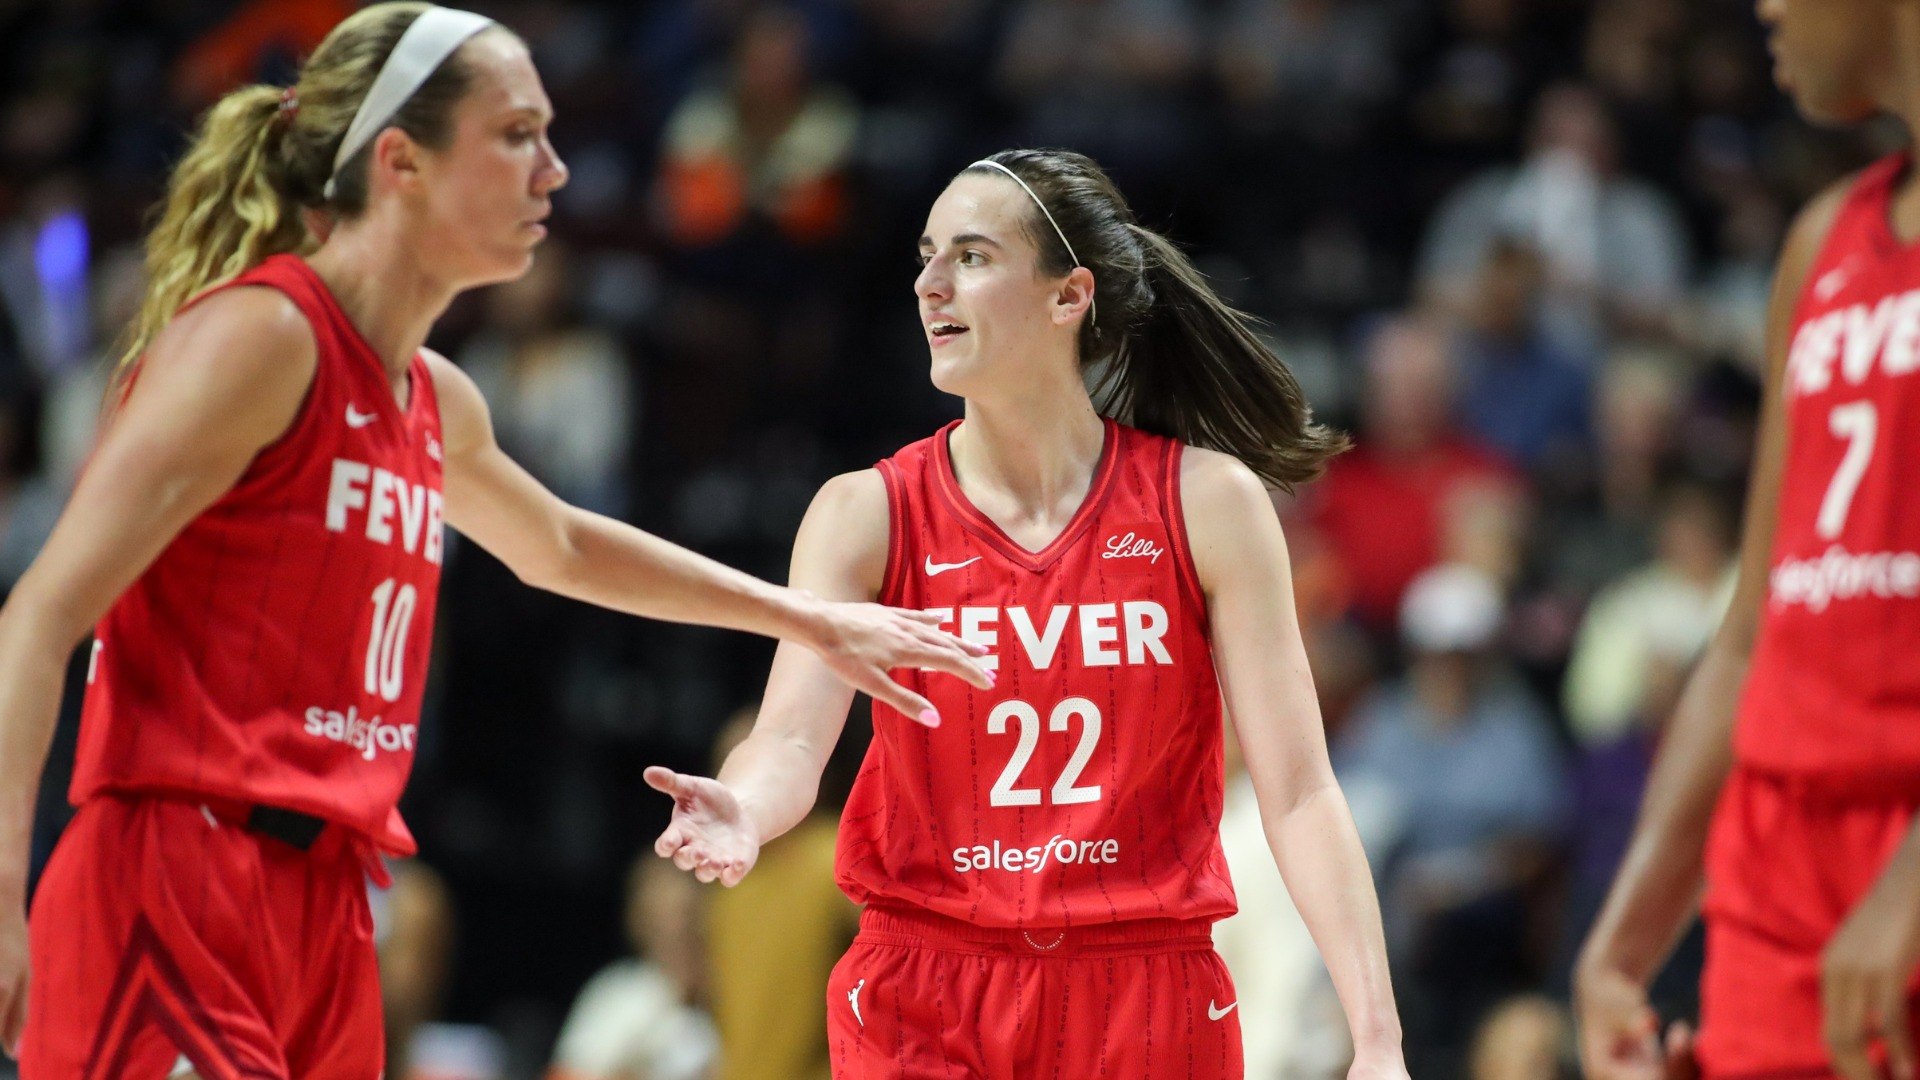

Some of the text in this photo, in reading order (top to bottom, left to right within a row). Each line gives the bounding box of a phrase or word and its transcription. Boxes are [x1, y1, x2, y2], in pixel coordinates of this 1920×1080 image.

[1814, 399, 1879, 540] 7
[1101, 531, 1165, 565] Lilly
[364, 577, 417, 702] 10
[986, 696, 1102, 808] 22
[952, 834, 1120, 874] salesforce
